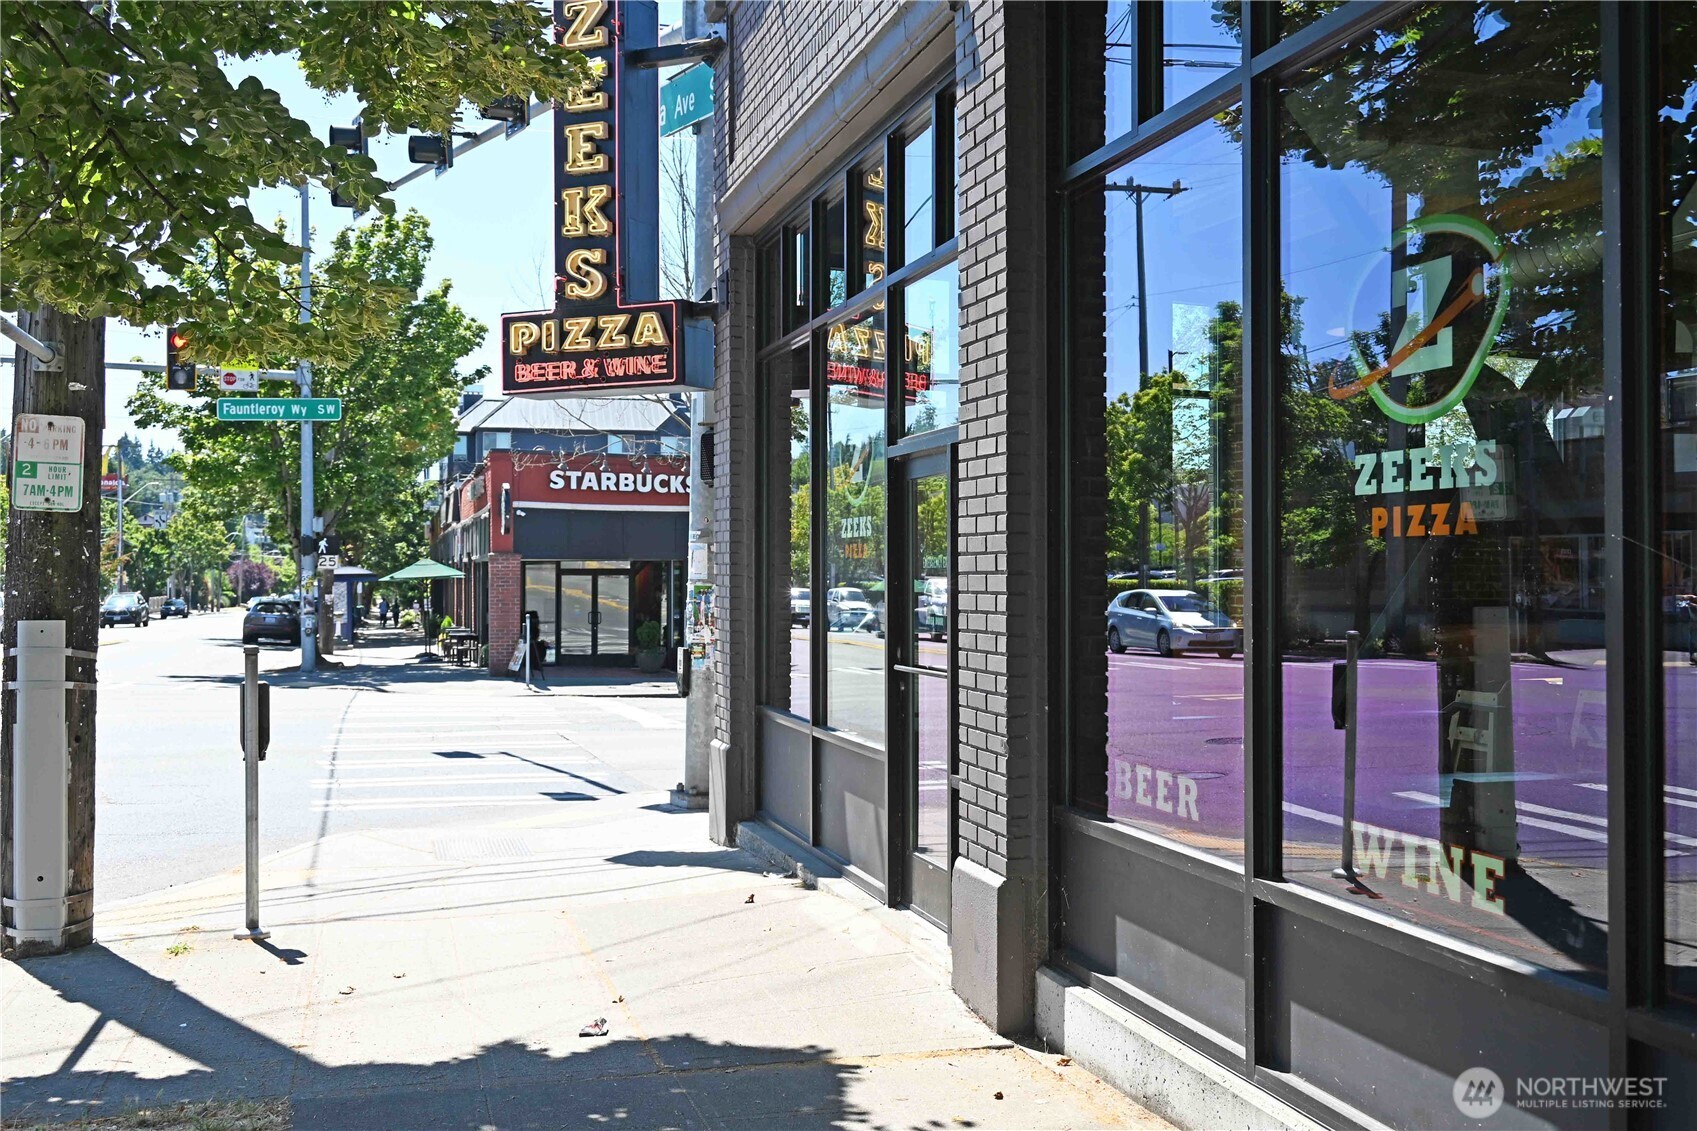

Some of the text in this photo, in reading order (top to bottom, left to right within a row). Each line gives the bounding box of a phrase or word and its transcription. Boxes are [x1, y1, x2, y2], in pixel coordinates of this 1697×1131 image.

[674, 92, 695, 120] Ave
[509, 311, 671, 356] PIZZA
[514, 354, 668, 383] BEER & WINE
[223, 402, 335, 417] Fauntleroy Wy SW
[21, 418, 37, 433] NO
[22, 463, 32, 476] 2
[1354, 439, 1498, 496] ZEEKS
[549, 470, 690, 494] STARBUCK
[841, 516, 872, 539] ZEEKS
[1371, 501, 1479, 538] PIZZA
[319, 556, 336, 567] 25
[1114, 758, 1199, 821] BEER
[1351, 821, 1506, 915] WINE
